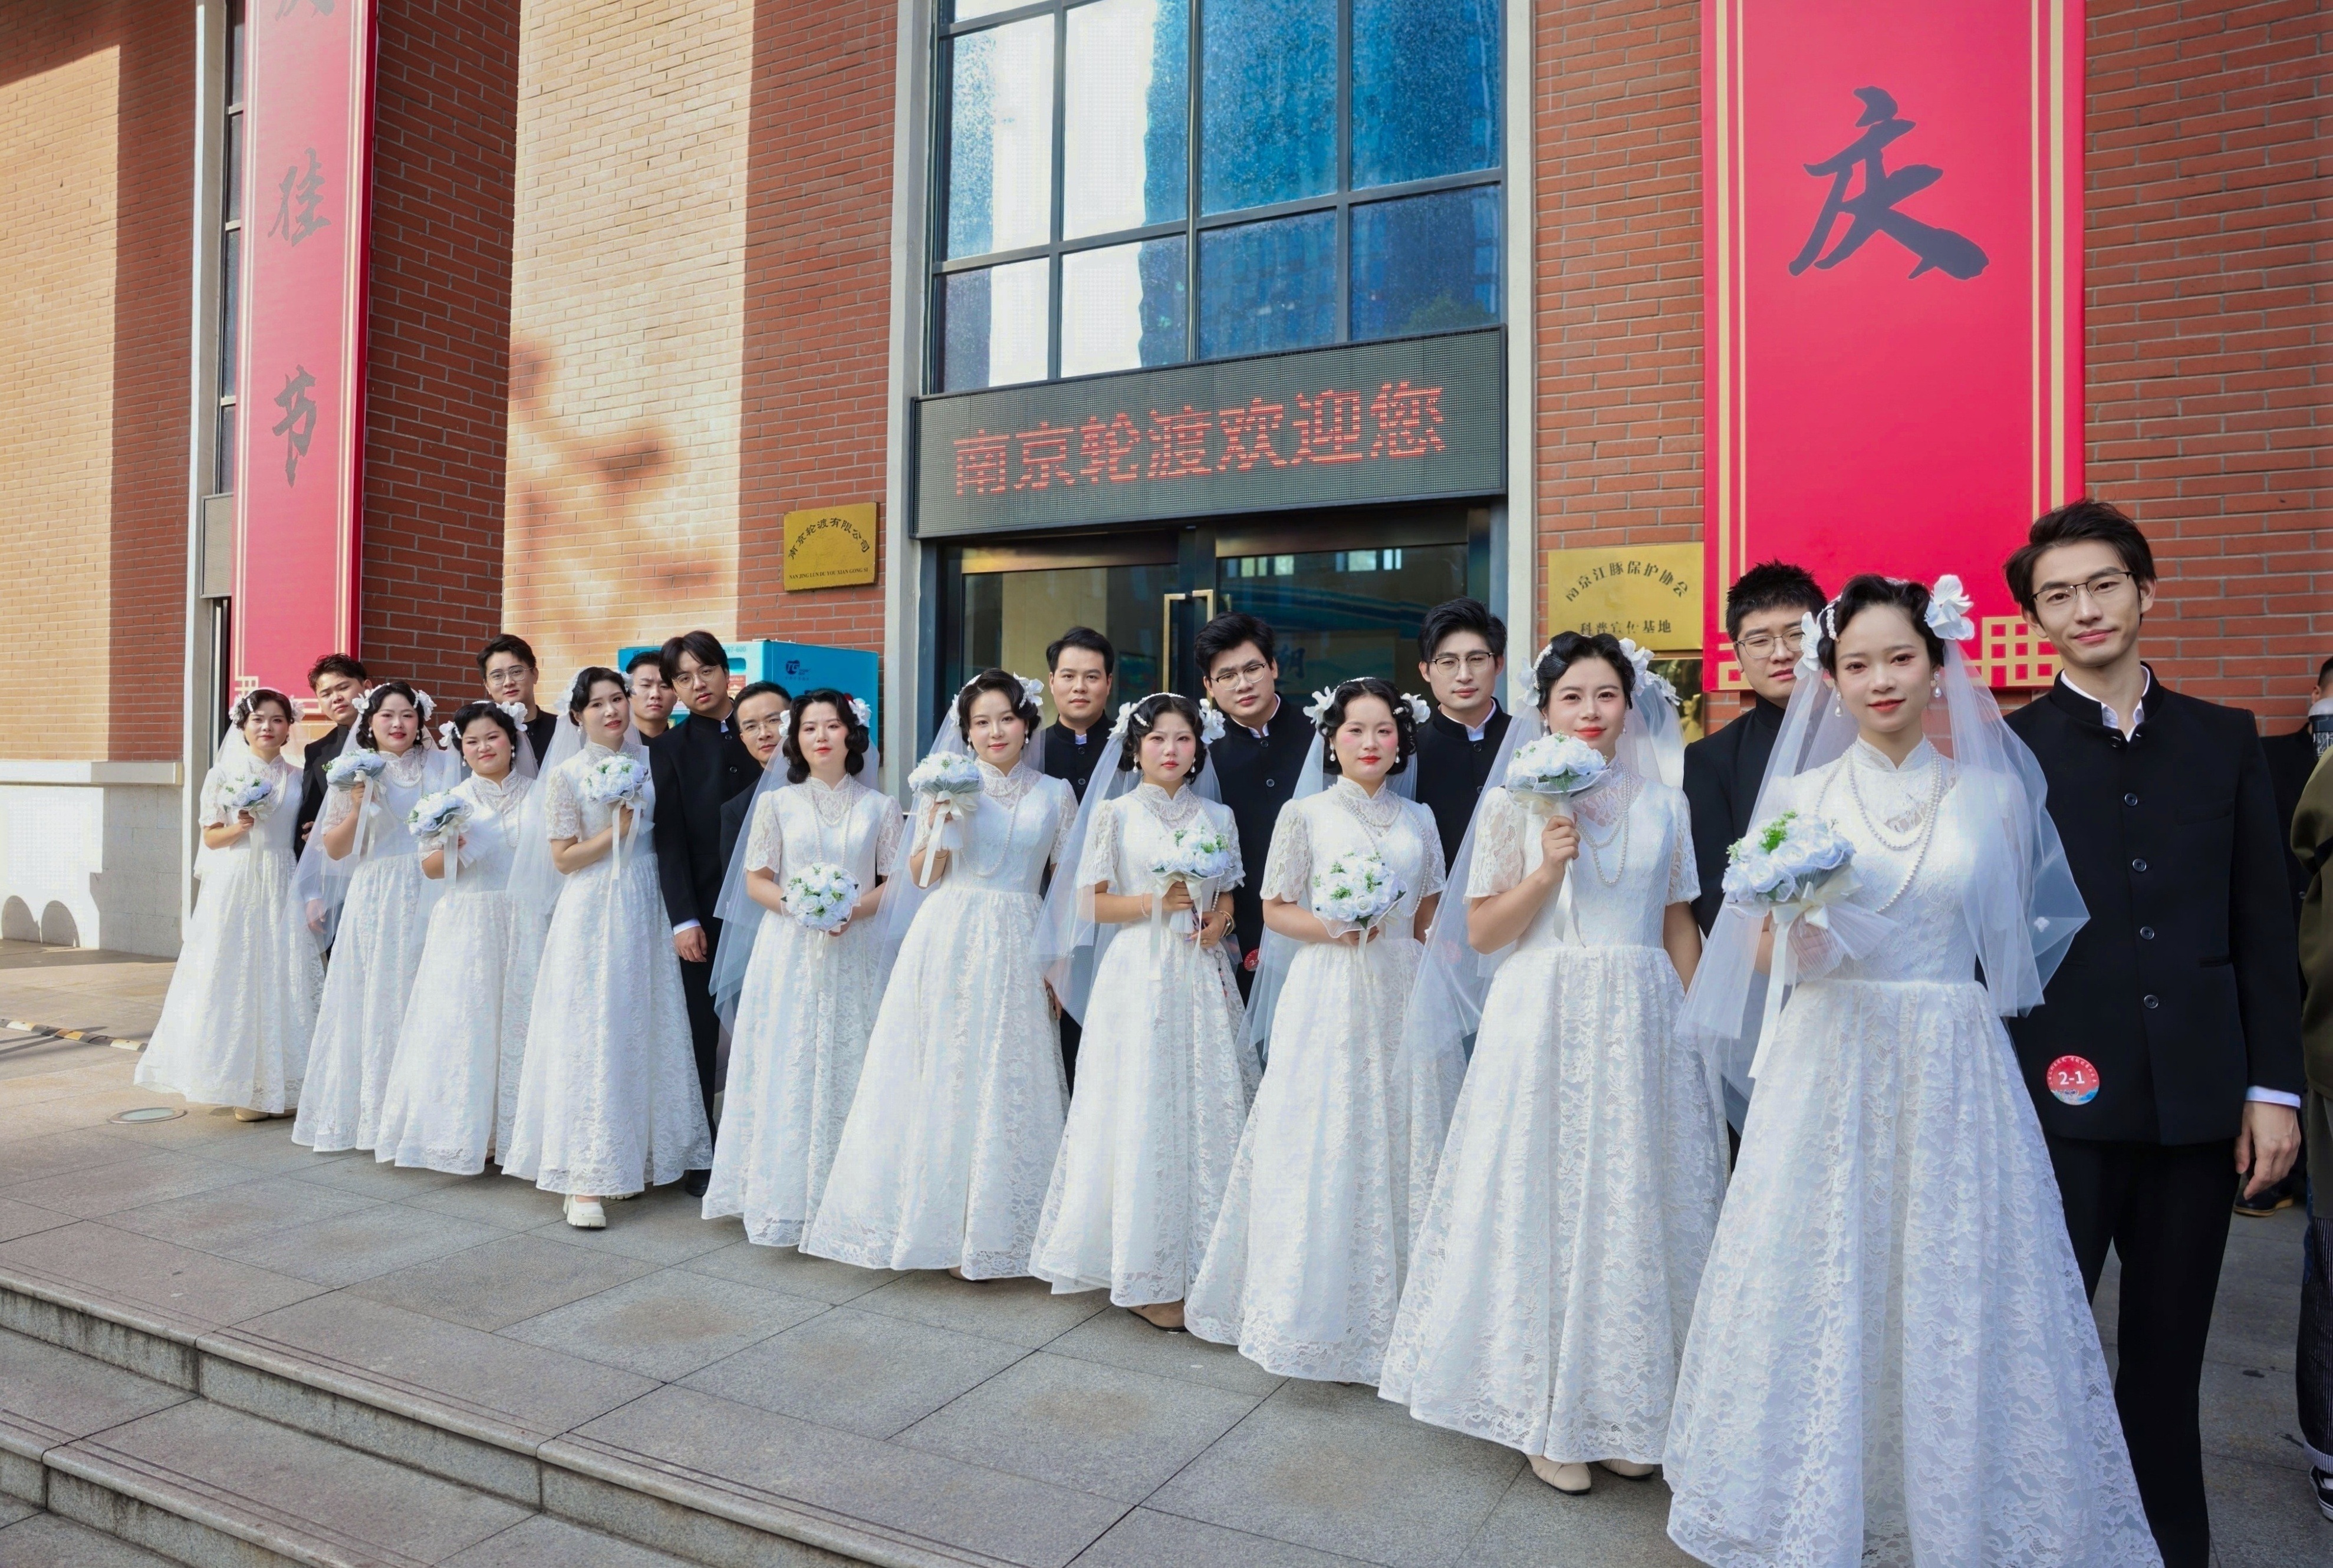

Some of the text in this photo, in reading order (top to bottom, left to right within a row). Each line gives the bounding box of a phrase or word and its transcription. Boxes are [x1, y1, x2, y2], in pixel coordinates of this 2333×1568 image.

[1789, 85, 1990, 280] 庆
[953, 381, 1444, 496] 南京轮渡欢迎您
[788, 517, 870, 559] 南京轮渡有限公司
[1565, 560, 1689, 602] 南京江豚保护协会
[2058, 1070, 2085, 1085] 2-1
